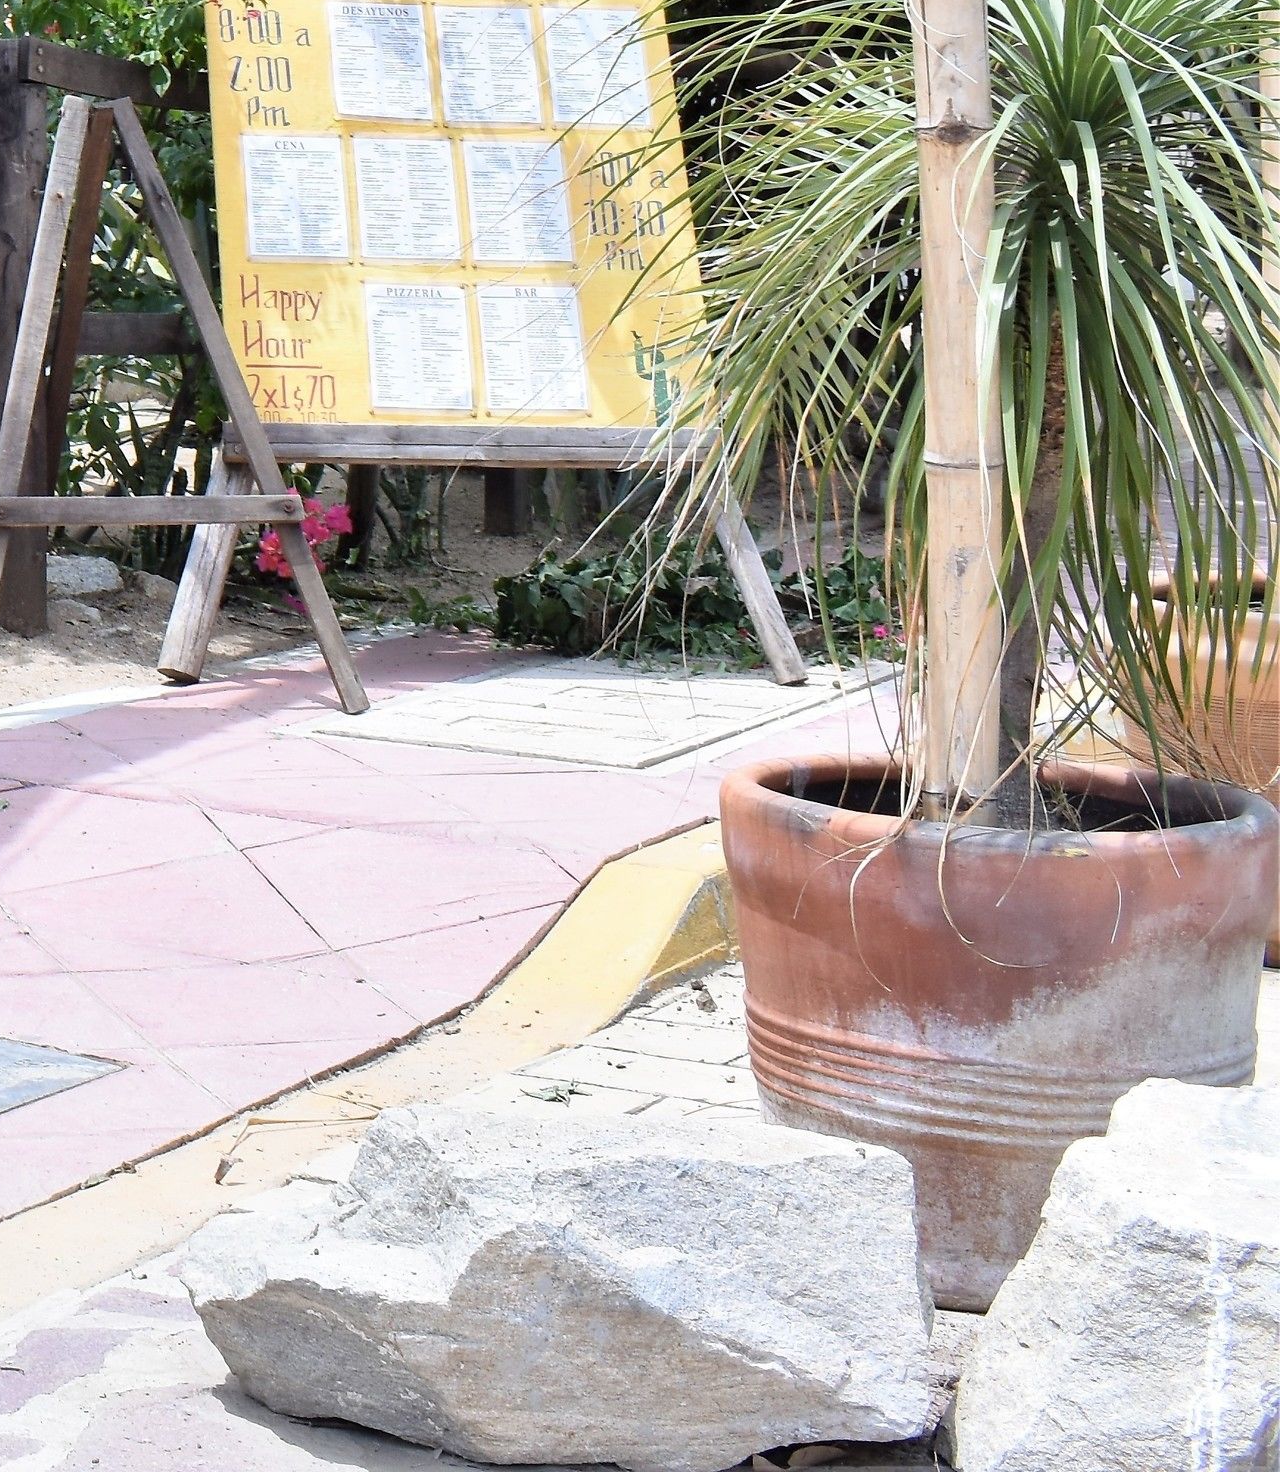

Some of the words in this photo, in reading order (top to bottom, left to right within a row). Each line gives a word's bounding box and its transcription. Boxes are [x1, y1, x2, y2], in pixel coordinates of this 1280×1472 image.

[218, 8, 282, 46] 8:00
[294, 27, 312, 47] a
[341, 5, 410, 17] DESAYUNOS
[228, 55, 293, 93] 2:00
[246, 95, 292, 127] Pm
[273, 139, 306, 150] CENA
[583, 198, 666, 237] 10:30
[239, 273, 323, 322] Happy
[514, 287, 538, 297] BAR
[241, 319, 312, 359] Hour
